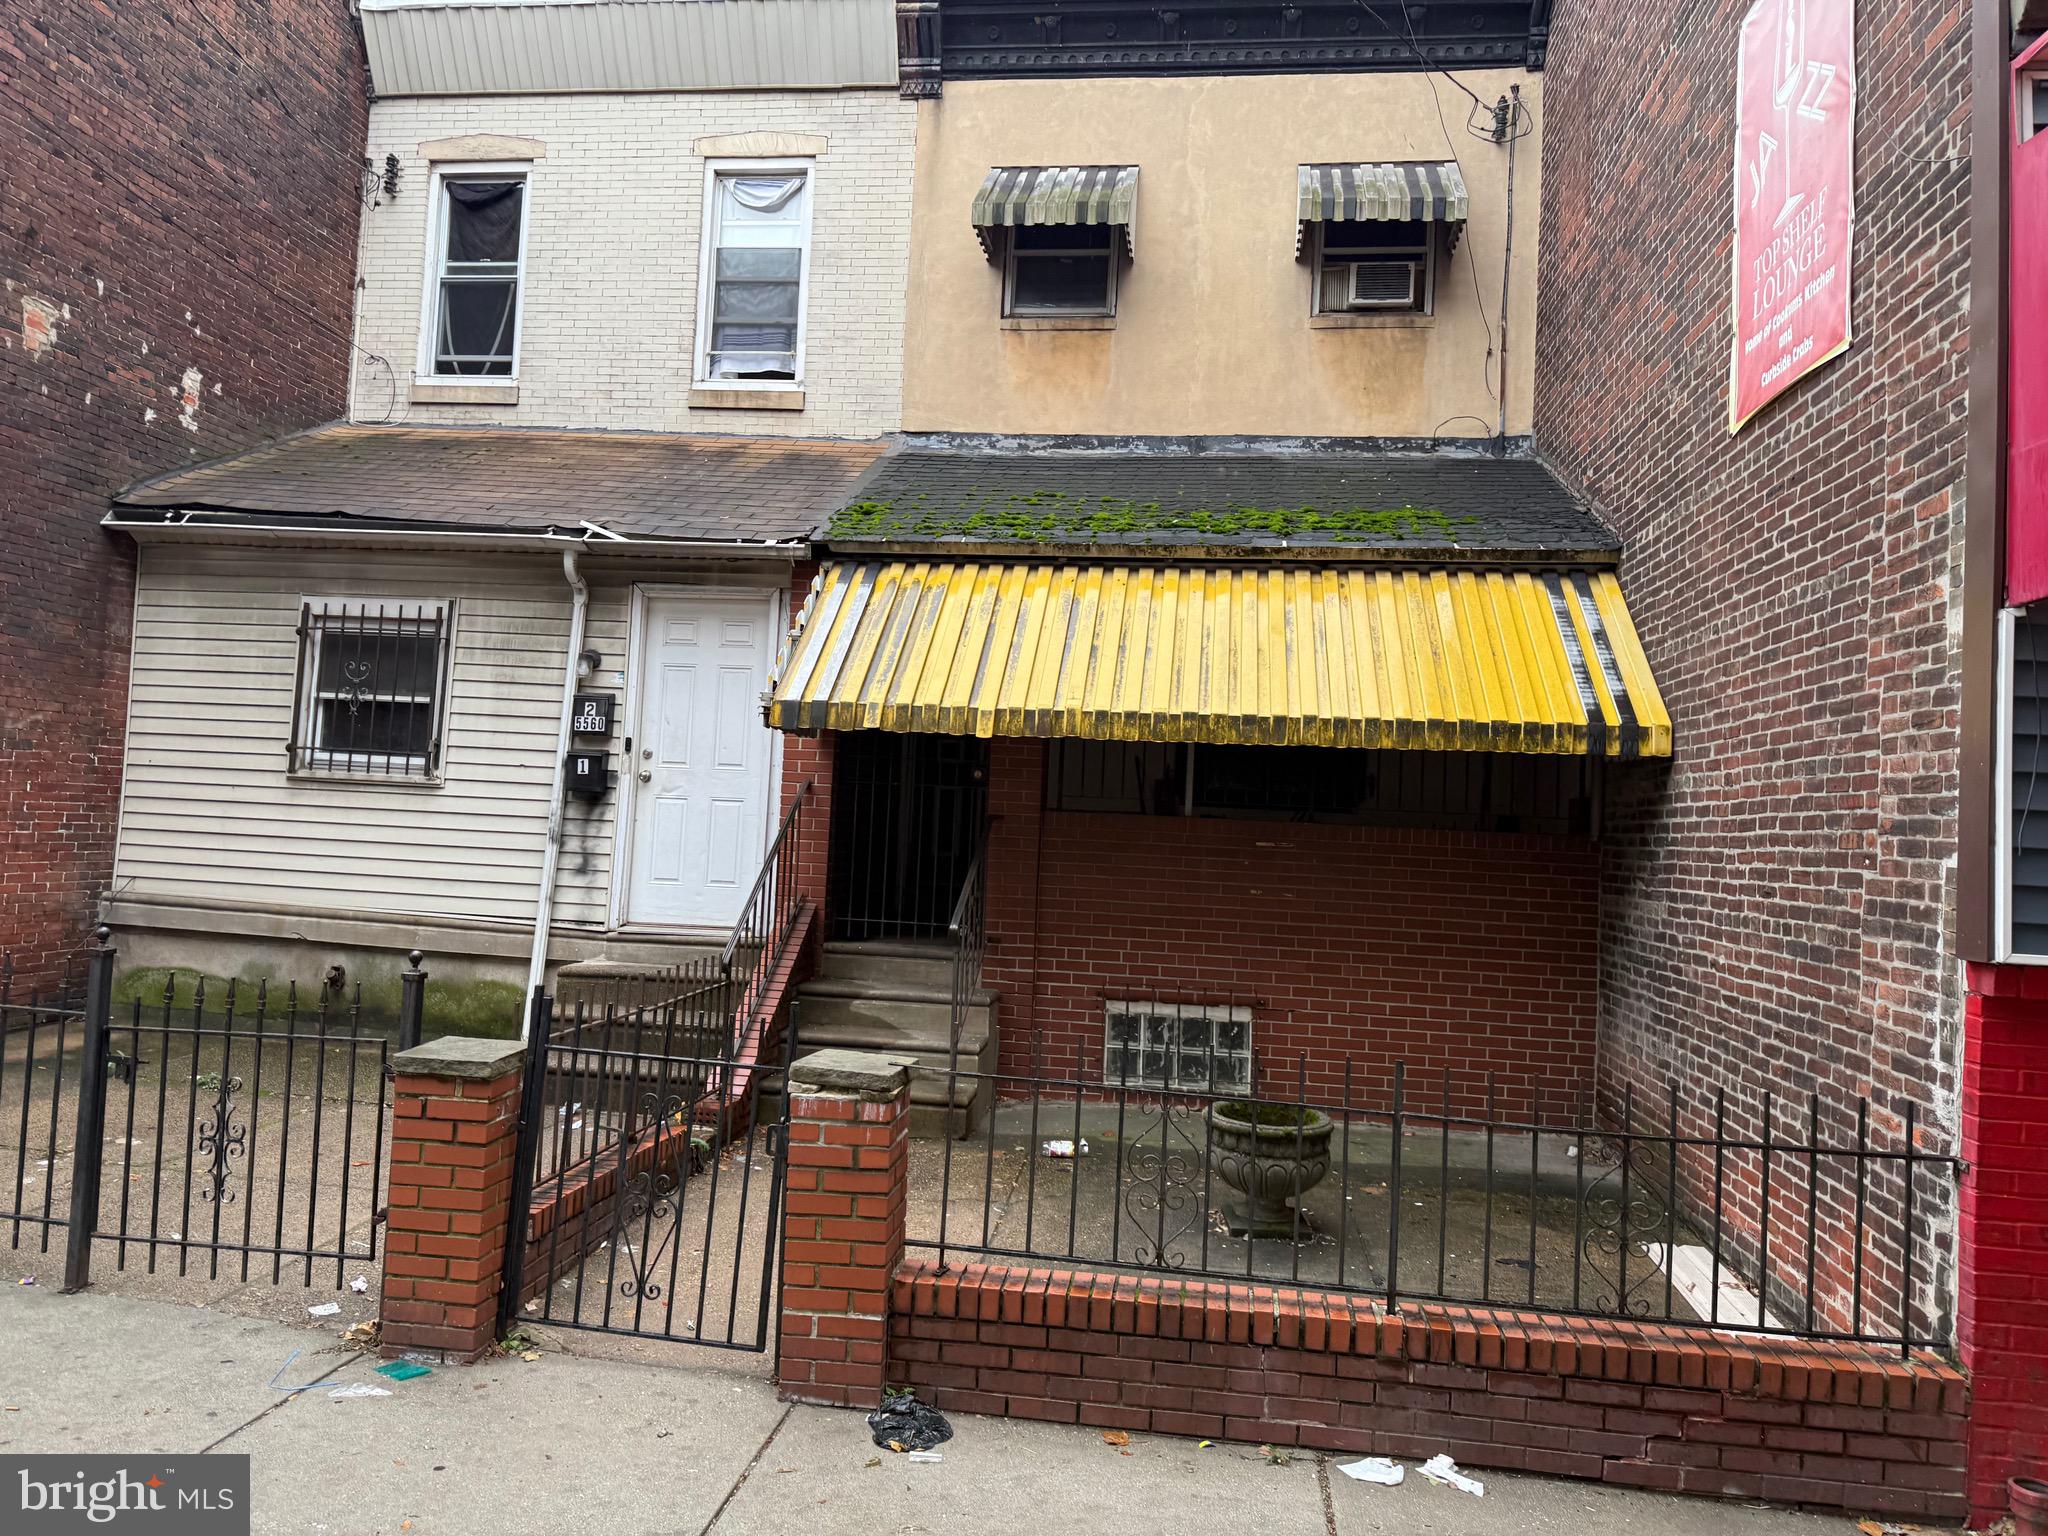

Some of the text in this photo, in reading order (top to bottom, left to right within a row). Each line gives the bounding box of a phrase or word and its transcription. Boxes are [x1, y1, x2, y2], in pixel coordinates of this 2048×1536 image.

[1753, 185, 1828, 285] TOP SHELF
[1752, 222, 1827, 320] LOUNGE
[1763, 319, 1772, 339] of
[1804, 264, 1836, 302] Kitchen
[1778, 324, 1793, 349] and
[1761, 335, 1814, 388] Curbside Crabs
[575, 717, 604, 730] 5560
[586, 703, 595, 716] 2
[579, 760, 586, 773] 1
